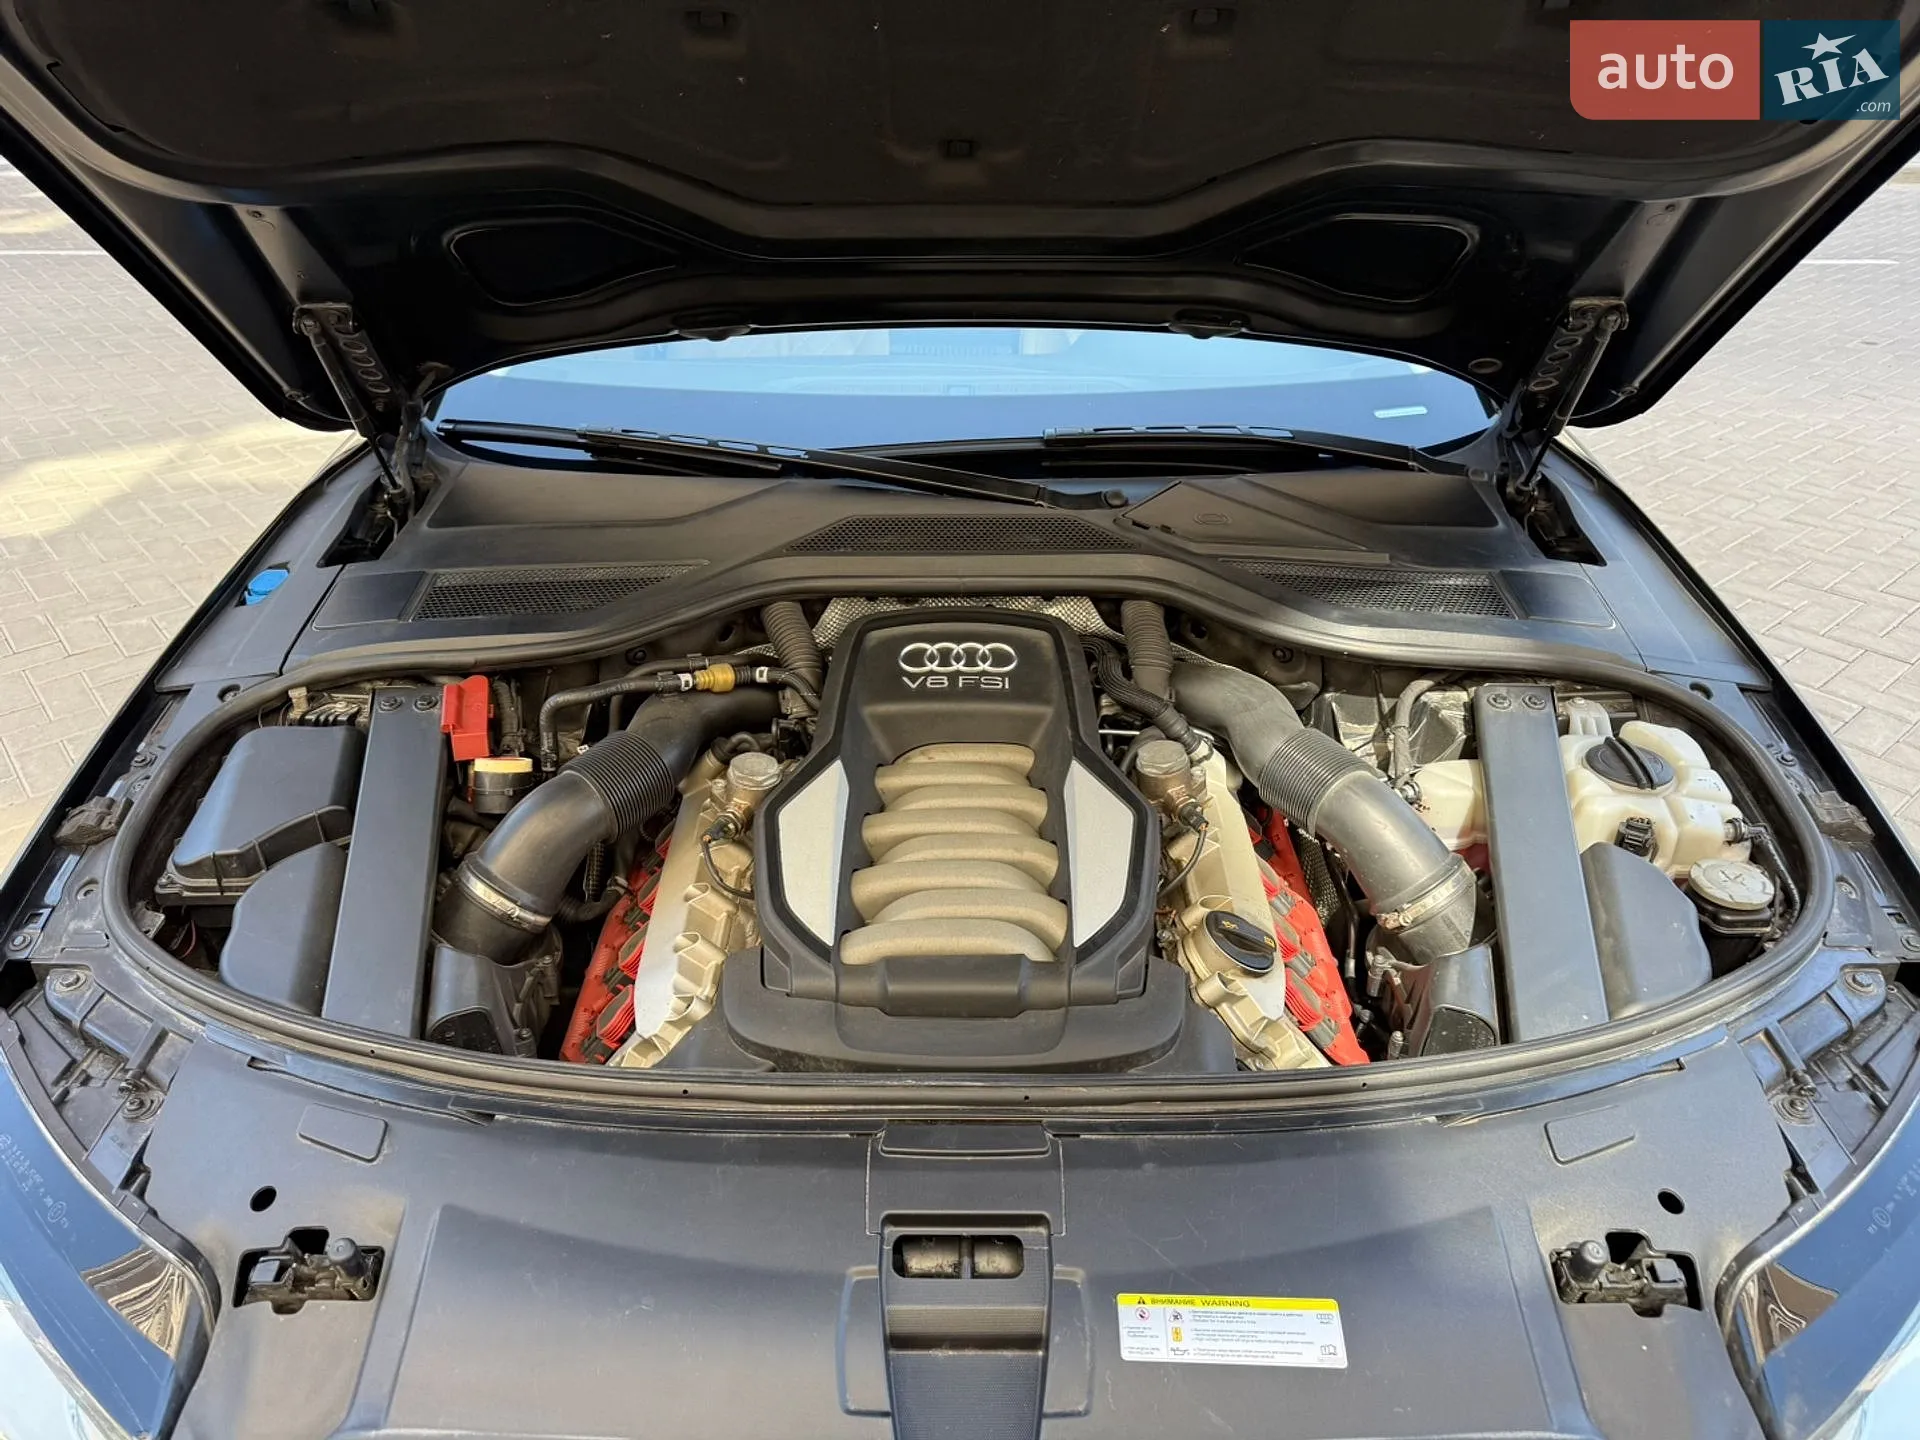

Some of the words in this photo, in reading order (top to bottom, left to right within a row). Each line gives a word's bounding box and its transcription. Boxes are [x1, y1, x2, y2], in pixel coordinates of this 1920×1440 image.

[902, 675, 949, 689] V8
[958, 675, 1009, 689] FSI
[1150, 1297, 1196, 1306] ВНИМАНИЕ
[1201, 1299, 1251, 1308] WARNING
